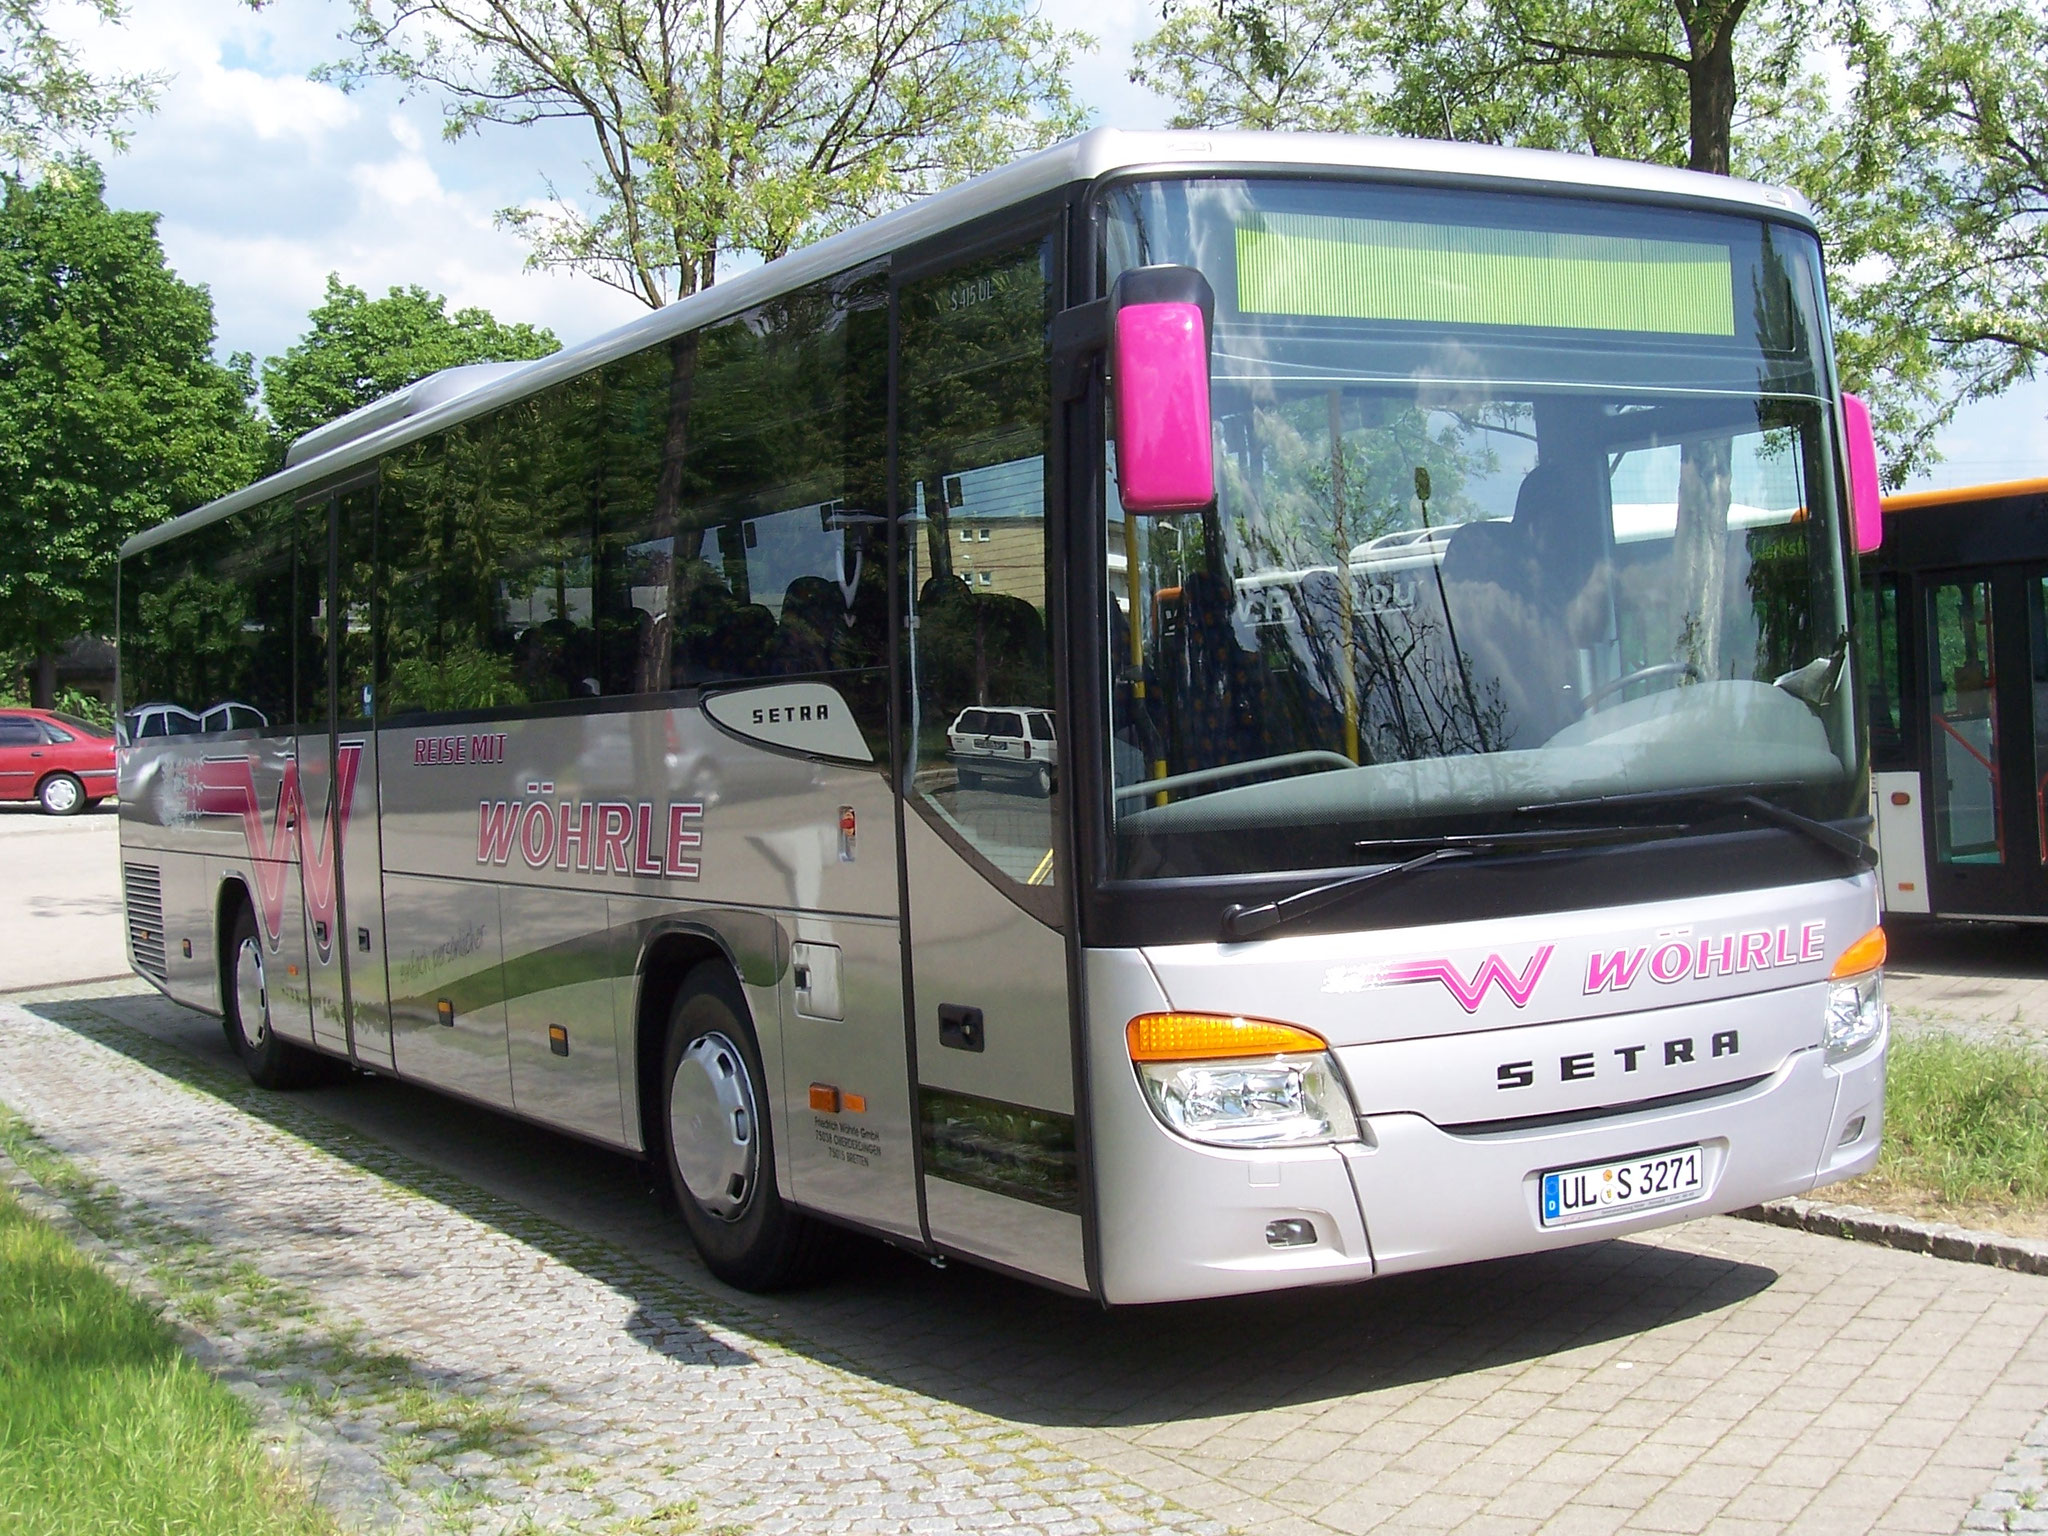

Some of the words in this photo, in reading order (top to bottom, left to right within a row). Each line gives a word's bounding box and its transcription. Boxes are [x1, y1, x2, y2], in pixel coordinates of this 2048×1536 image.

[959, 284, 976, 308] 415
[978, 279, 993, 302] UL
[752, 704, 828, 724] SETRA
[413, 735, 467, 766] REISE
[469, 732, 508, 764] MIT
[476, 781, 704, 882] WÖHRLE
[1582, 920, 1827, 996] WÖHRLE
[1496, 1029, 1740, 1091] SETRA
[1562, 1175, 1597, 1210] UL
[1617, 1167, 1632, 1200] S
[1639, 1153, 1699, 1196] 3271
[1549, 1200, 1556, 1211] D
